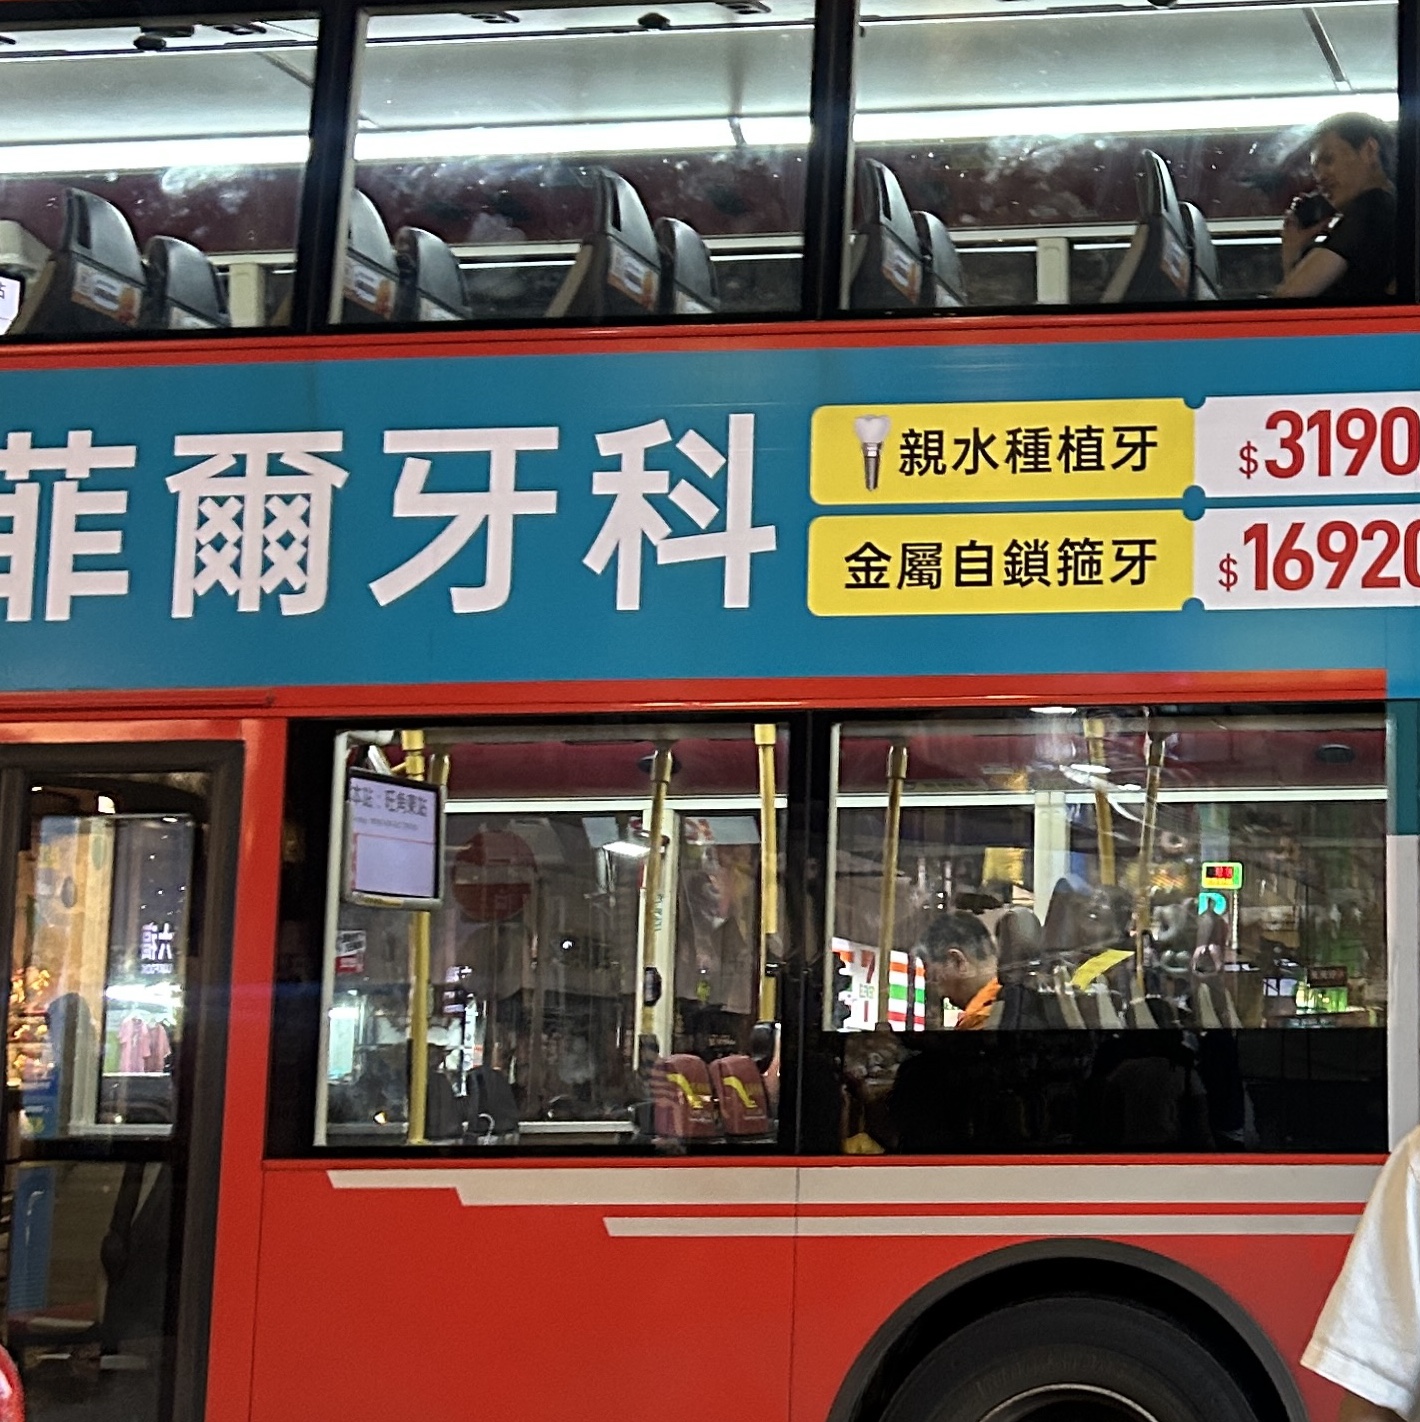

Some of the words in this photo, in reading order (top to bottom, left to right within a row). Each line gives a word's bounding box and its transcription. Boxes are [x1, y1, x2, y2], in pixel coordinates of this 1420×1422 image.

[898, 424, 1159, 478] 親水種植牙
[0, 413, 777, 622] 菲爾牙科
[844, 538, 1158, 590] 金屬自鎖箍牙
